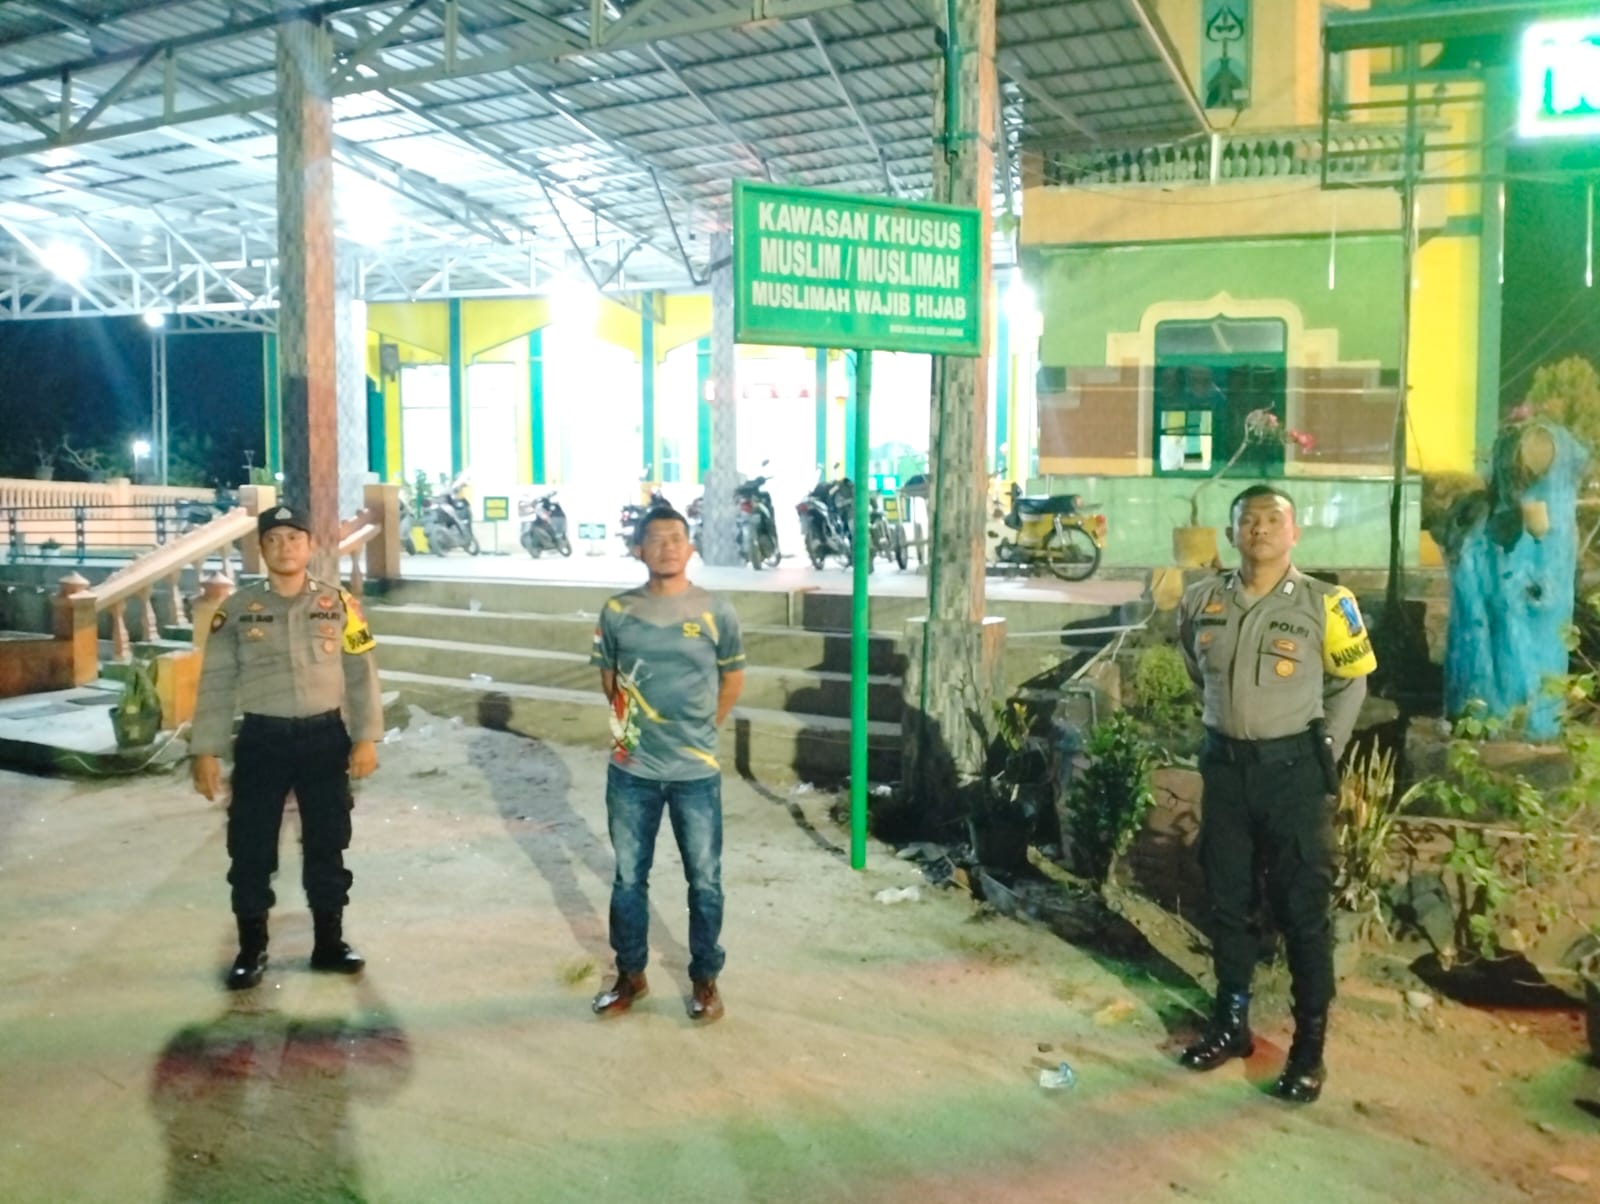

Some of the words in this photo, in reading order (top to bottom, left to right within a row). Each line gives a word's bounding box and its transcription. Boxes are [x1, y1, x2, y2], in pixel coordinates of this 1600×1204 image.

[759, 202, 869, 241] KAWASAN
[874, 214, 961, 249] KHUSUS
[760, 237, 841, 279] MUSLIM
[845, 246, 852, 280] /
[857, 247, 959, 288] MUSLIMAH
[752, 281, 850, 312] MUSLIMAH
[854, 289, 910, 317] WAJIB
[915, 294, 967, 320] HIJAB
[1269, 620, 1310, 638] POLRI
